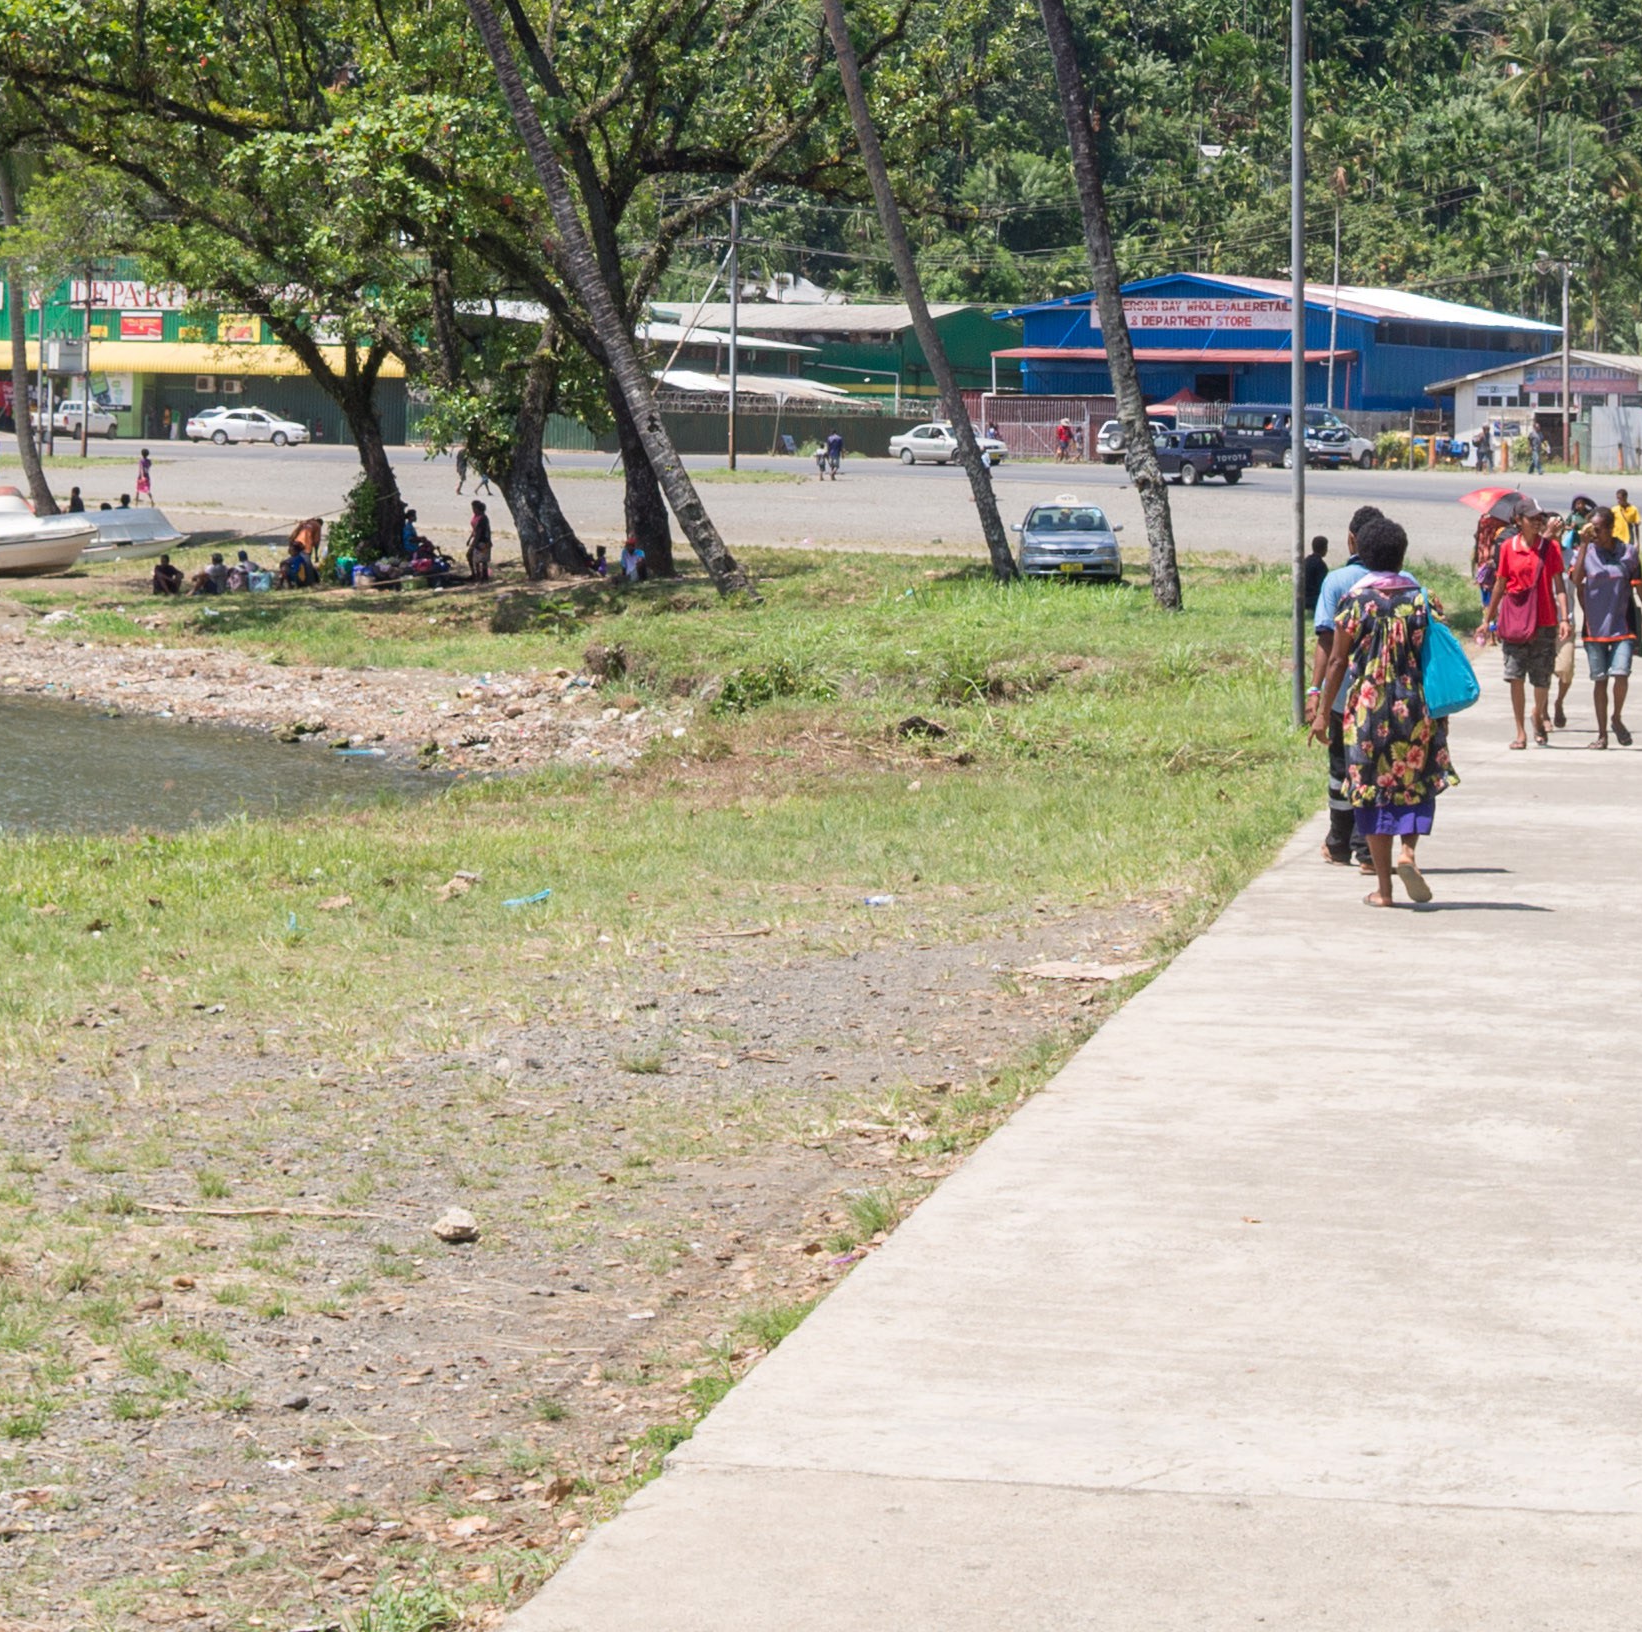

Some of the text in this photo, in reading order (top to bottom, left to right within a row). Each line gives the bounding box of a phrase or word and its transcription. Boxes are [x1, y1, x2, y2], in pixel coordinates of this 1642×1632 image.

[1130, 315, 1139, 326] &
[1141, 315, 1213, 327] DEPARTMENT
[1216, 315, 1253, 327] STORE
[1589, 368, 1638, 380] LIMITED
[1216, 453, 1248, 463] TOYOTA
